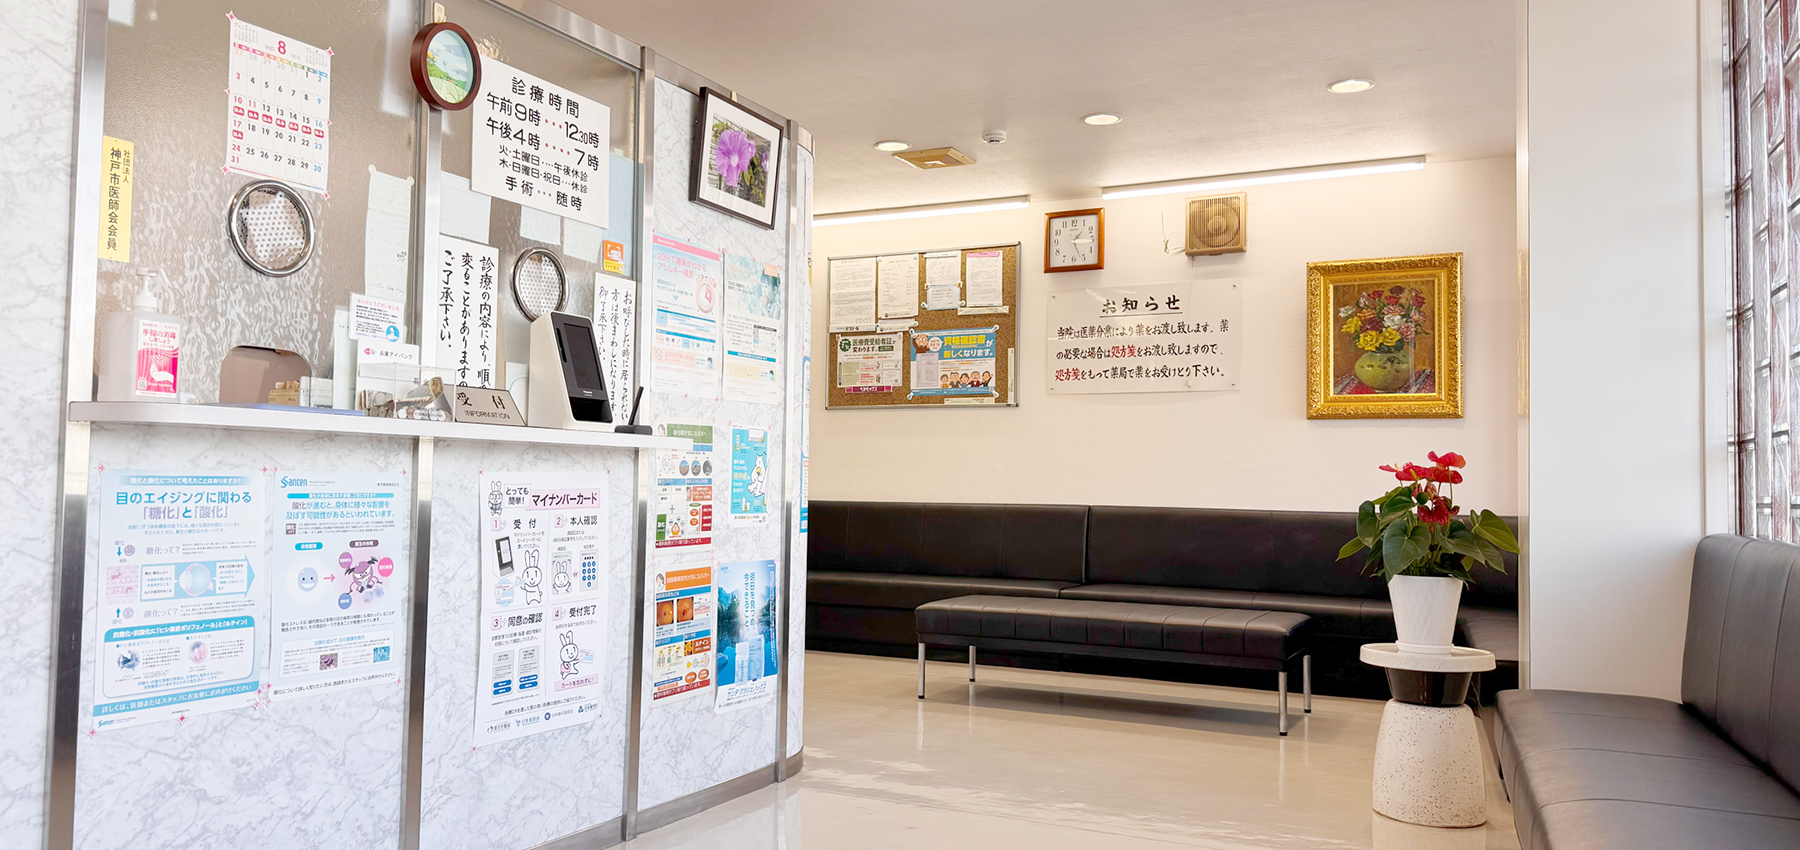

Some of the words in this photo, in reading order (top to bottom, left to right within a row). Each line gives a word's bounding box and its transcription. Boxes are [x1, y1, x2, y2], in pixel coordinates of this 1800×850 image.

[278, 40, 286, 55] 8
[236, 72, 240, 80] 3
[512, 76, 579, 118] 診療時間
[234, 96, 242, 104] 10
[248, 100, 256, 108] 11
[262, 104, 271, 112] 12
[276, 108, 284, 116] 13
[289, 112, 297, 120] 14
[302, 116, 310, 124] 15
[315, 120, 322, 128] 16
[315, 142, 322, 150] 23
[232, 144, 240, 152] 24
[246, 147, 255, 155] 25
[260, 151, 269, 159] 26
[288, 158, 296, 166] 28
[301, 161, 309, 169] 29
[107, 146, 121, 250] 神戸市医師会会員
[1055, 248, 1060, 256] 8
[657, 252, 706, 272] 20分で結果がわかる
[1081, 254, 1086, 262] 5
[658, 262, 694, 279] アレルギー検査
[357, 299, 400, 311] ありがとうございました
[1102, 294, 1181, 314] お知らせ
[477, 256, 495, 389] 診療の内容により、順
[142, 328, 176, 339] 手指の消毒
[852, 338, 896, 346] 医療費受給者証が
[380, 350, 412, 359] 兵庫アイバンク
[944, 349, 993, 358] 新しくなります。
[457, 392, 505, 409] 受付
[464, 410, 510, 419] INFORMATION
[281, 476, 308, 488] Santen
[506, 487, 529, 495] とっても
[116, 491, 251, 505] 目のエイジングに関わる
[532, 493, 597, 506] マイナンバーカード
[292, 501, 390, 510] 酸化が進むと、身体に様々な影響を
[144, 506, 228, 520] 「糖化」と「酸化」
[286, 510, 394, 520] 及ぼす可能性があるといわれています。
[514, 518, 536, 529] 受付
[556, 517, 561, 525] 2
[570, 516, 598, 526] 本人確認
[146, 546, 180, 555] 糖化って?
[144, 608, 178, 618] 酸化って?
[569, 605, 596, 618] 受付完了
[494, 619, 498, 627] 3
[508, 612, 543, 627] 同意の確認
[98, 720, 114, 728] Santen
